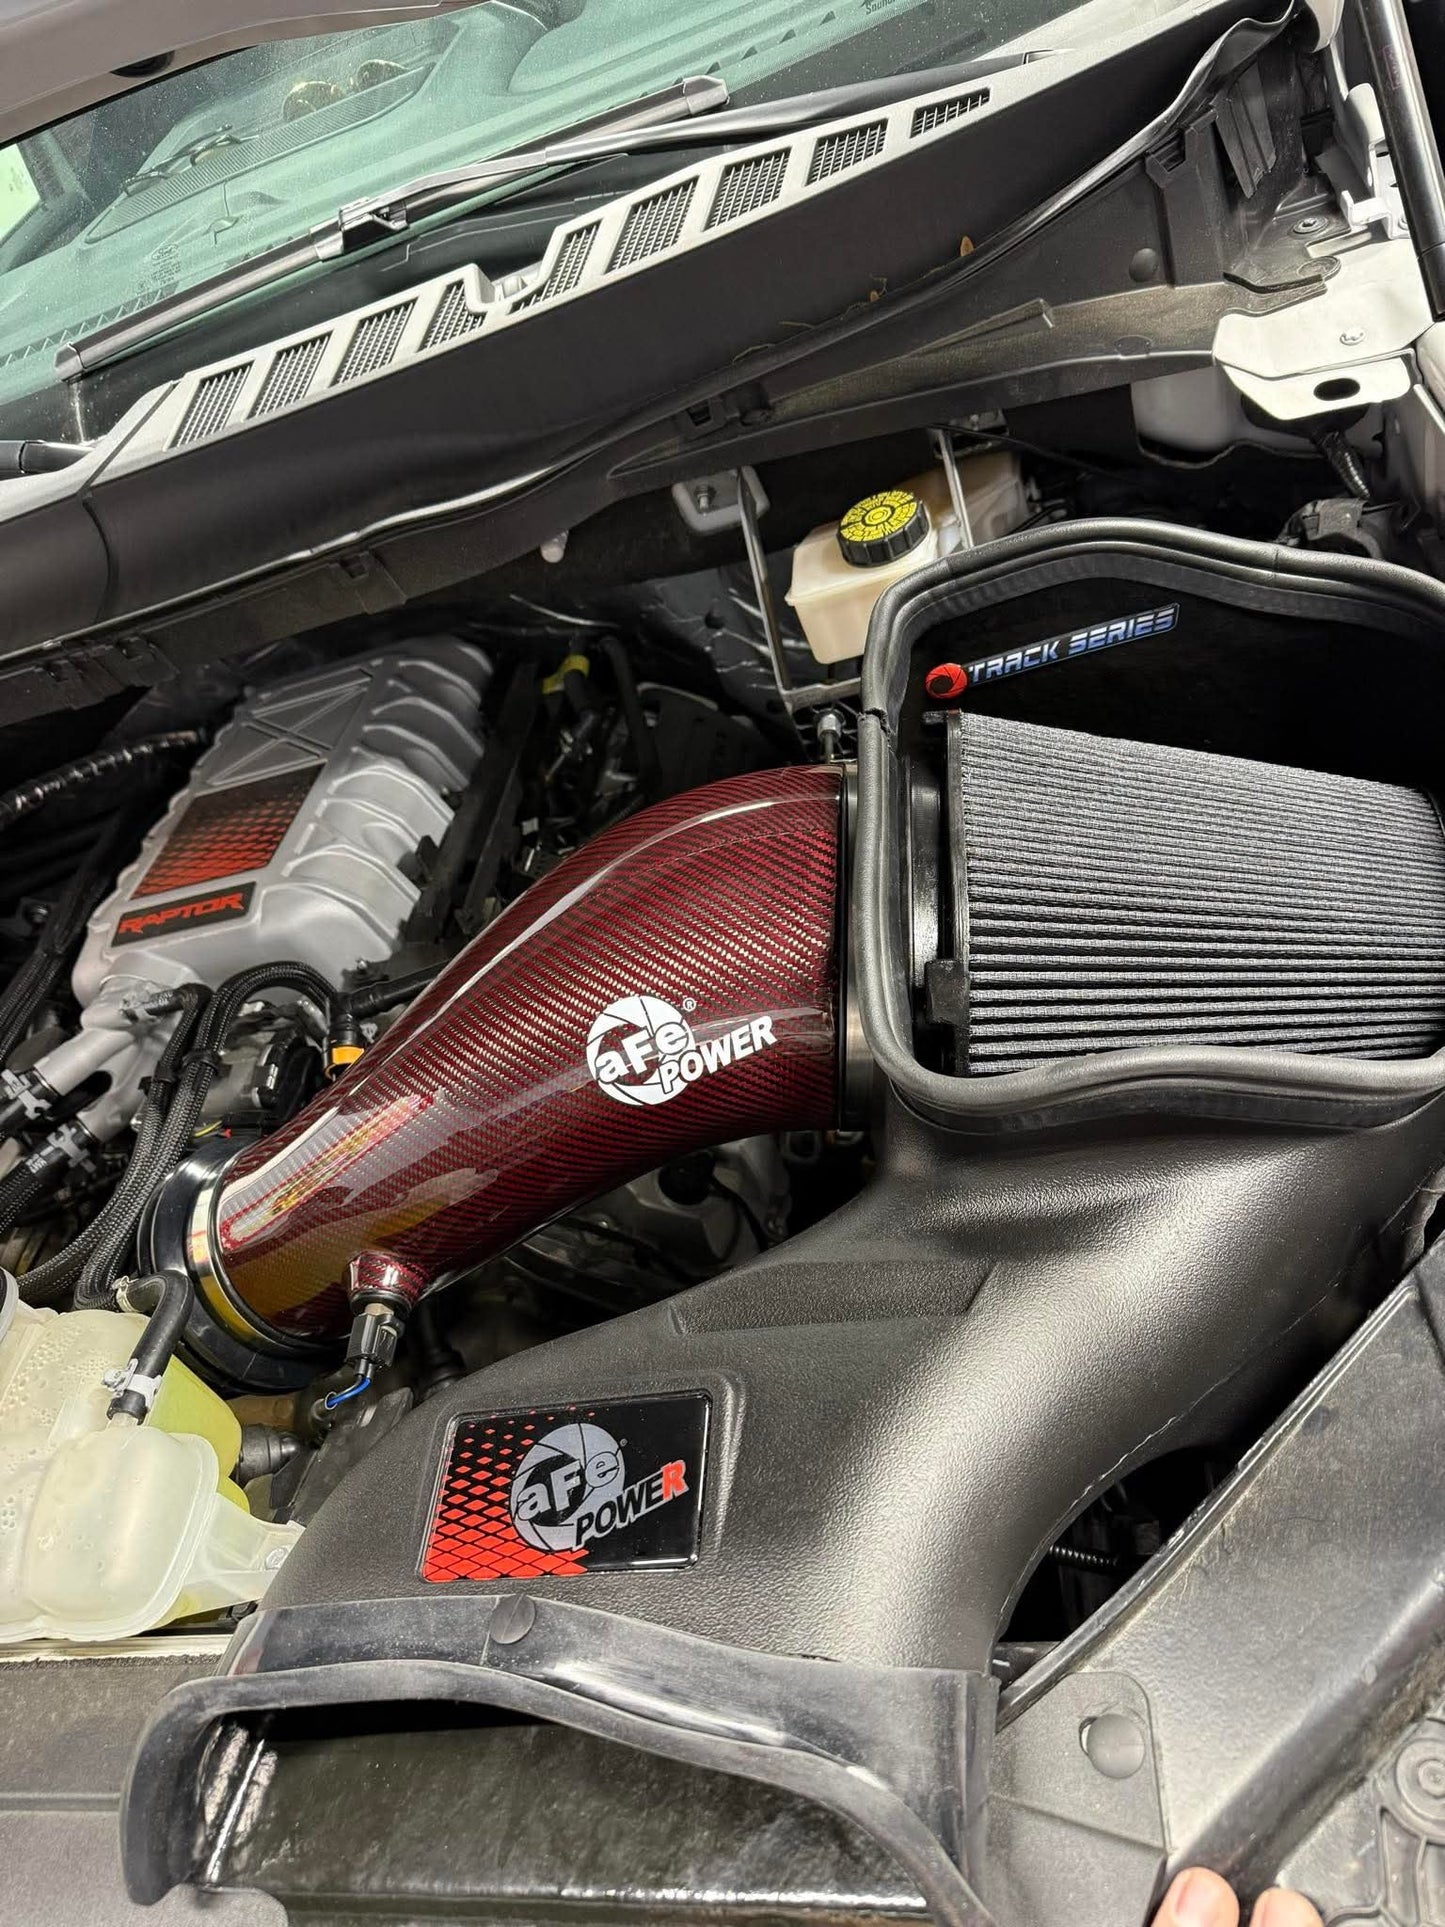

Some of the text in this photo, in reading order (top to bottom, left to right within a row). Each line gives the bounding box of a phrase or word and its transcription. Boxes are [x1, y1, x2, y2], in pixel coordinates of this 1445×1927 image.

[969, 608, 1175, 682] TRACK SERIES
[118, 892, 244, 934] RAPTOR
[596, 1022, 690, 1084] aFe
[658, 1015, 778, 1095] POWER
[516, 1451, 620, 1521] aFe
[574, 1460, 691, 1551] POWER
